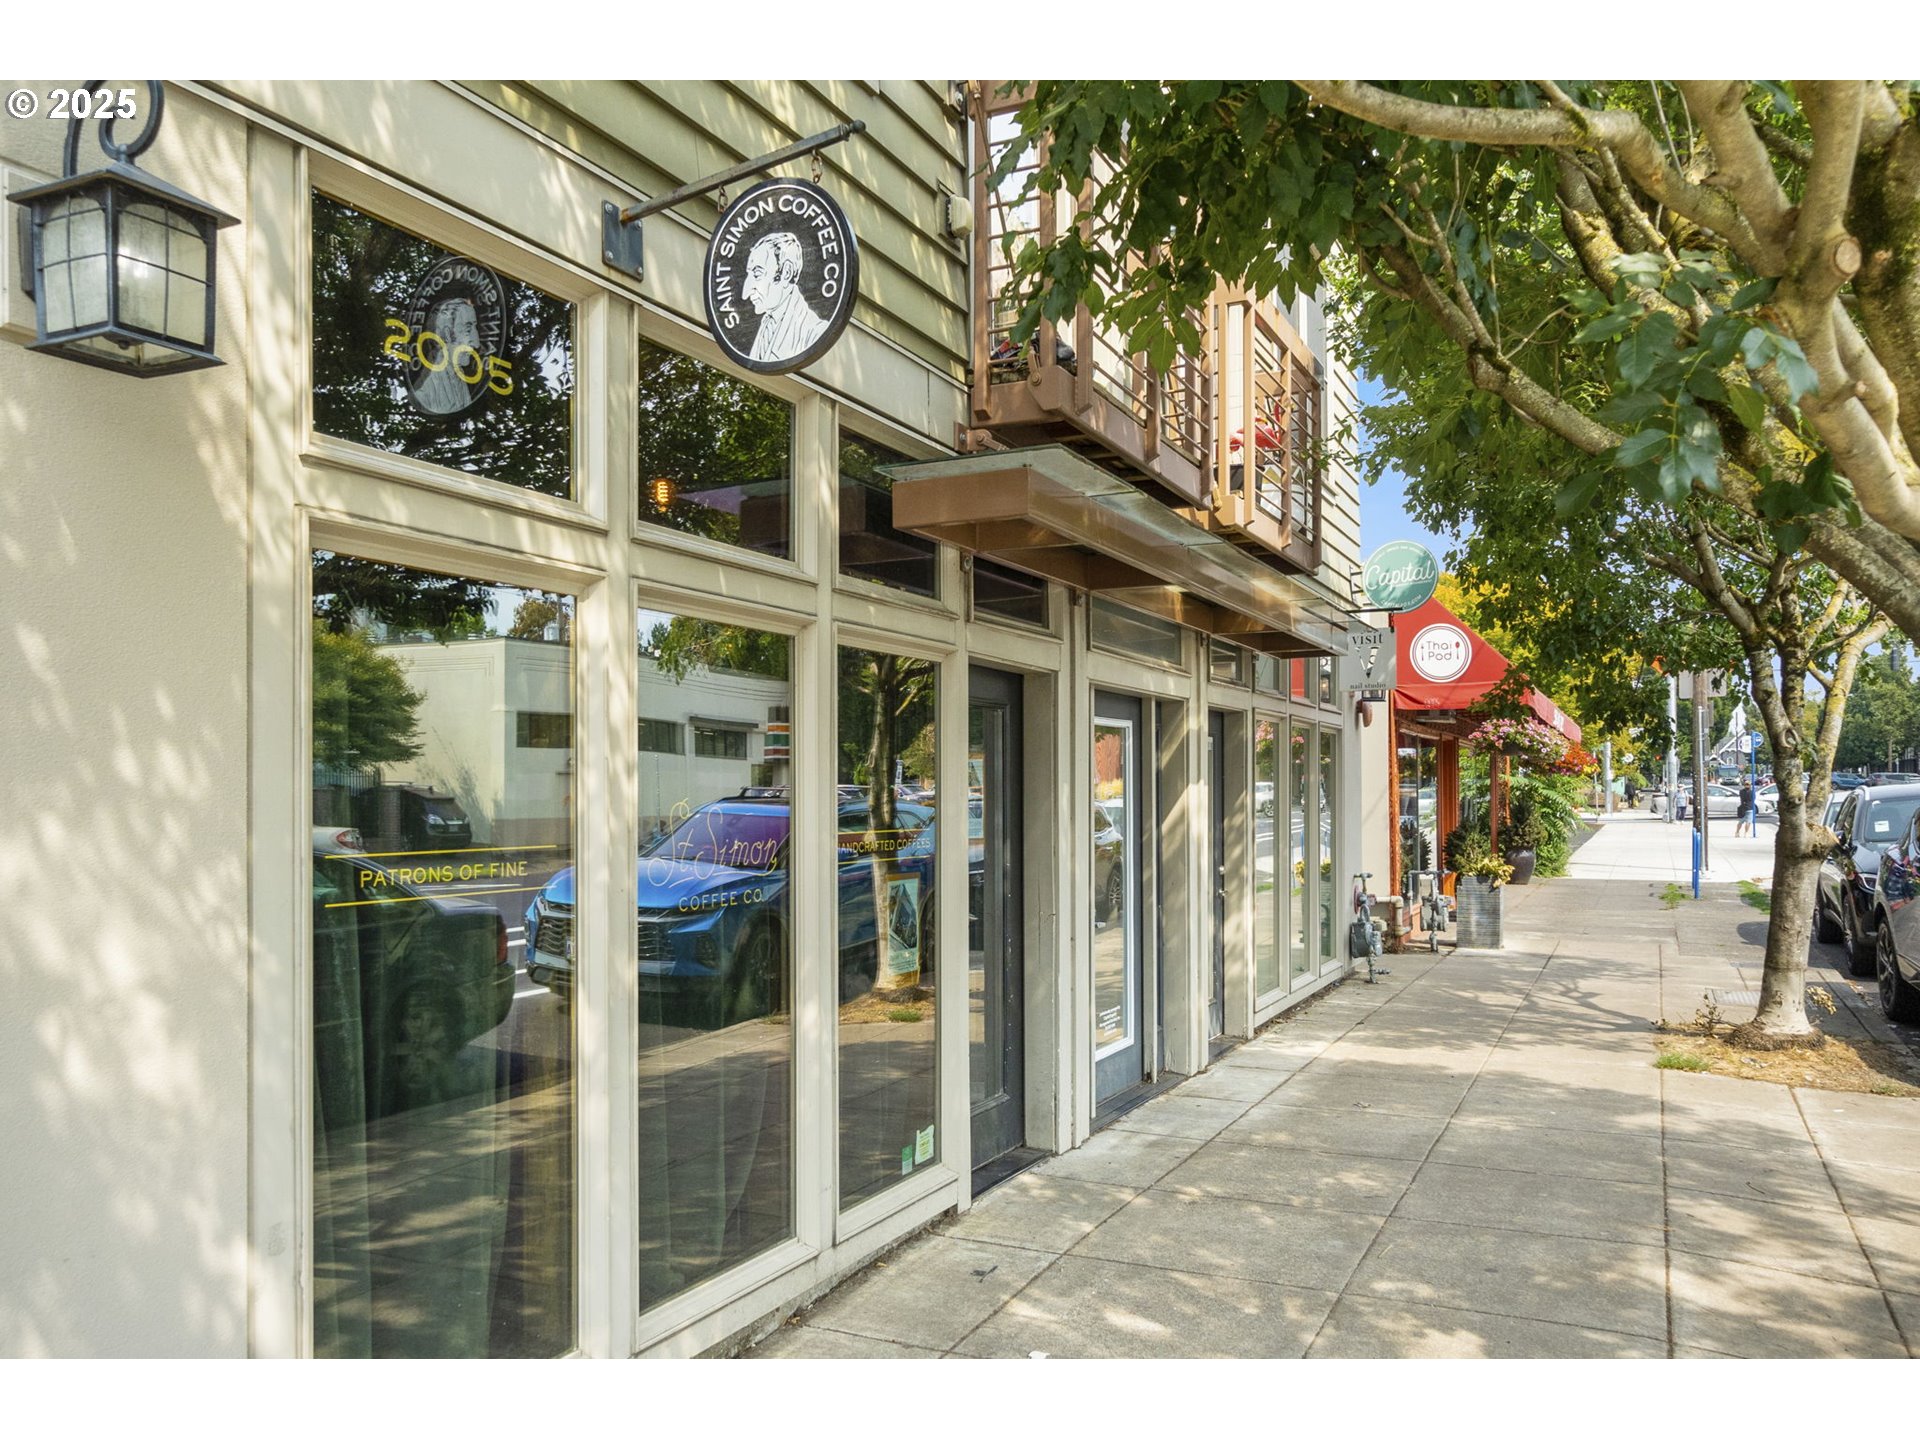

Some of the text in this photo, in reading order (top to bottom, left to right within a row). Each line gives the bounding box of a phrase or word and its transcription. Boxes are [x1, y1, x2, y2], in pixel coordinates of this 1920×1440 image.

[716, 194, 840, 329] SAINT SIMON COFFEE CO
[384, 318, 514, 396] 2005
[1366, 560, 1435, 591] Capital
[1426, 640, 1452, 650] Thai
[1428, 651, 1452, 661] Pod
[694, 806, 778, 880] Simon
[897, 838, 931, 850] COFFEES
[360, 861, 528, 888] PATRONS OF FINE
[679, 891, 737, 912] COFFEE
